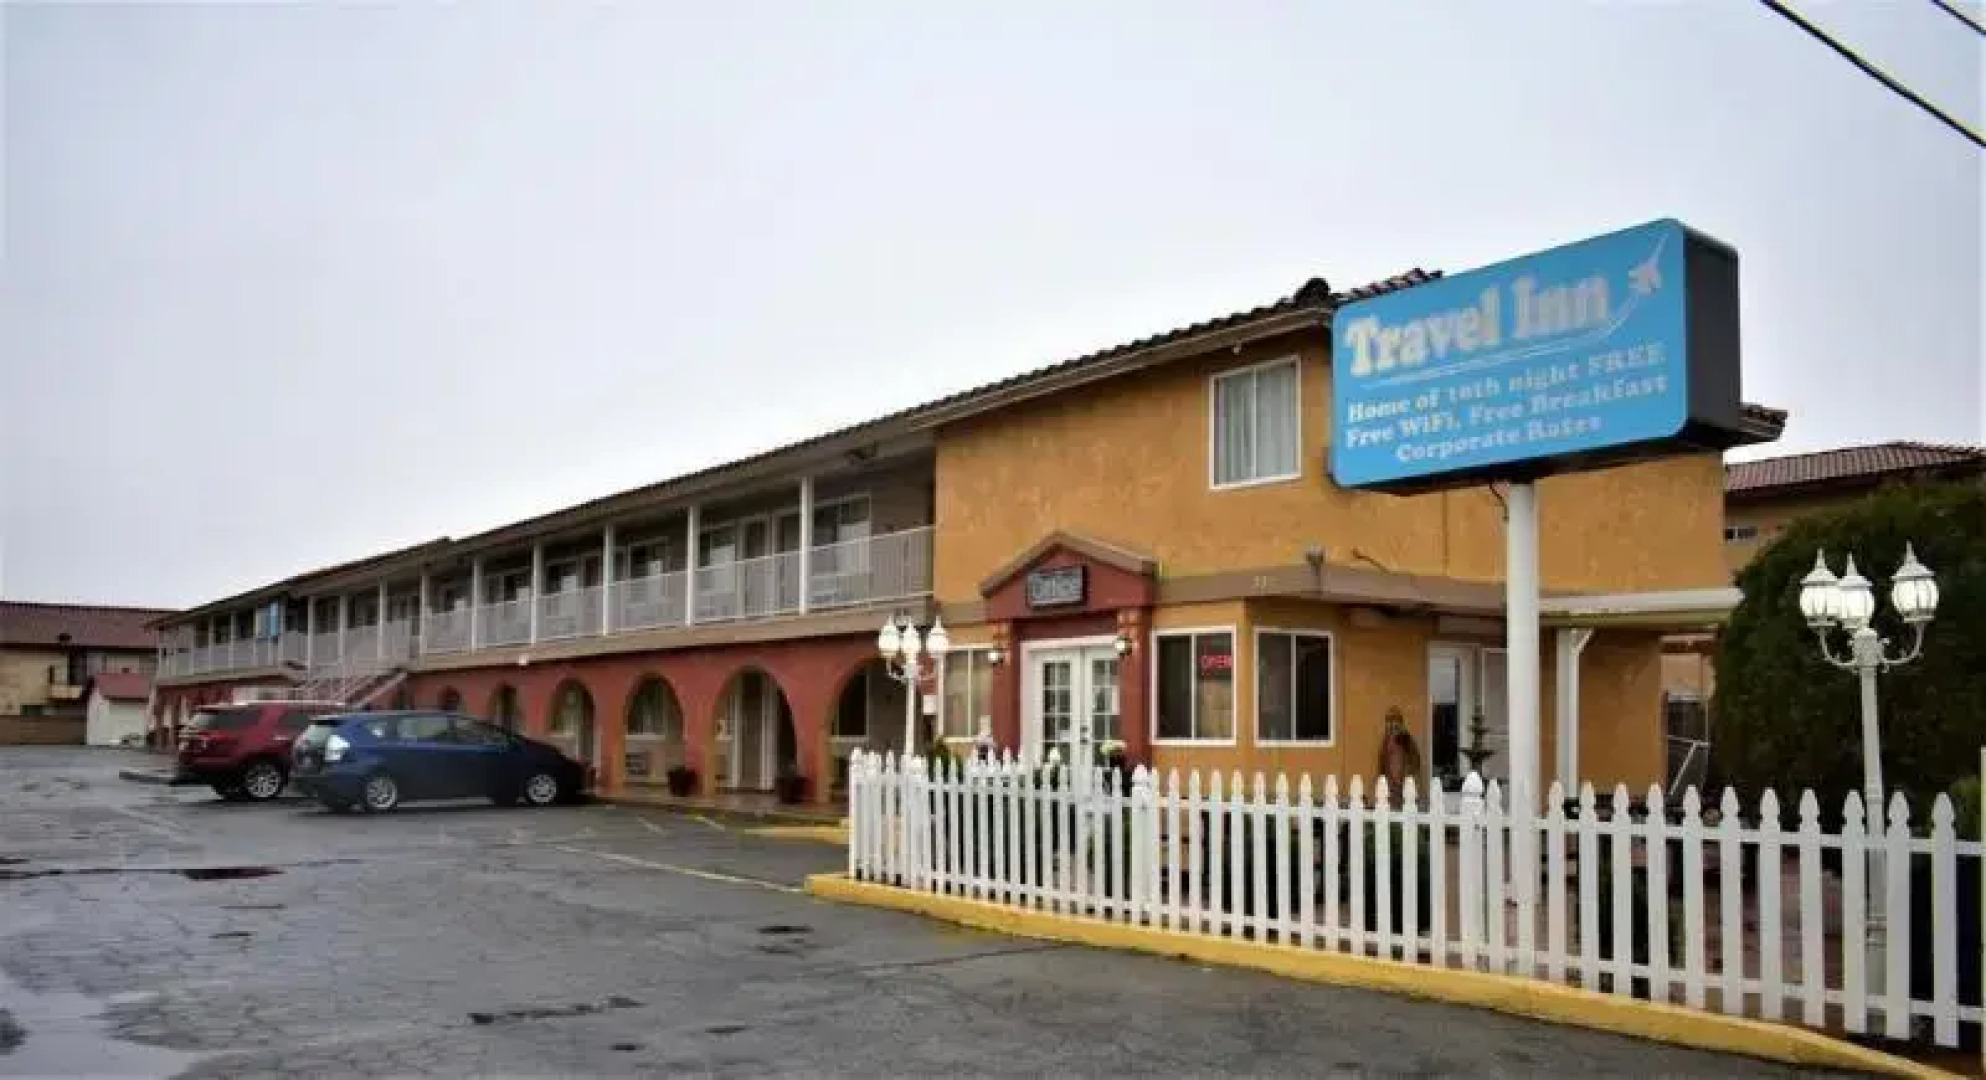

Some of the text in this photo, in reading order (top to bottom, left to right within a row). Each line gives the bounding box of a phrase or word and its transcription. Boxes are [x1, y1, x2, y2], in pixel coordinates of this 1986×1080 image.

[1345, 275, 1609, 377] Travel Inn
[1348, 400, 1410, 423] Home
[1415, 387, 1440, 409] of
[1509, 363, 1579, 394] night
[1588, 340, 1667, 376] FREE
[1347, 427, 1393, 448] Free
[1469, 405, 1523, 426] Free
[1396, 417, 1600, 461] Corporate Rates
